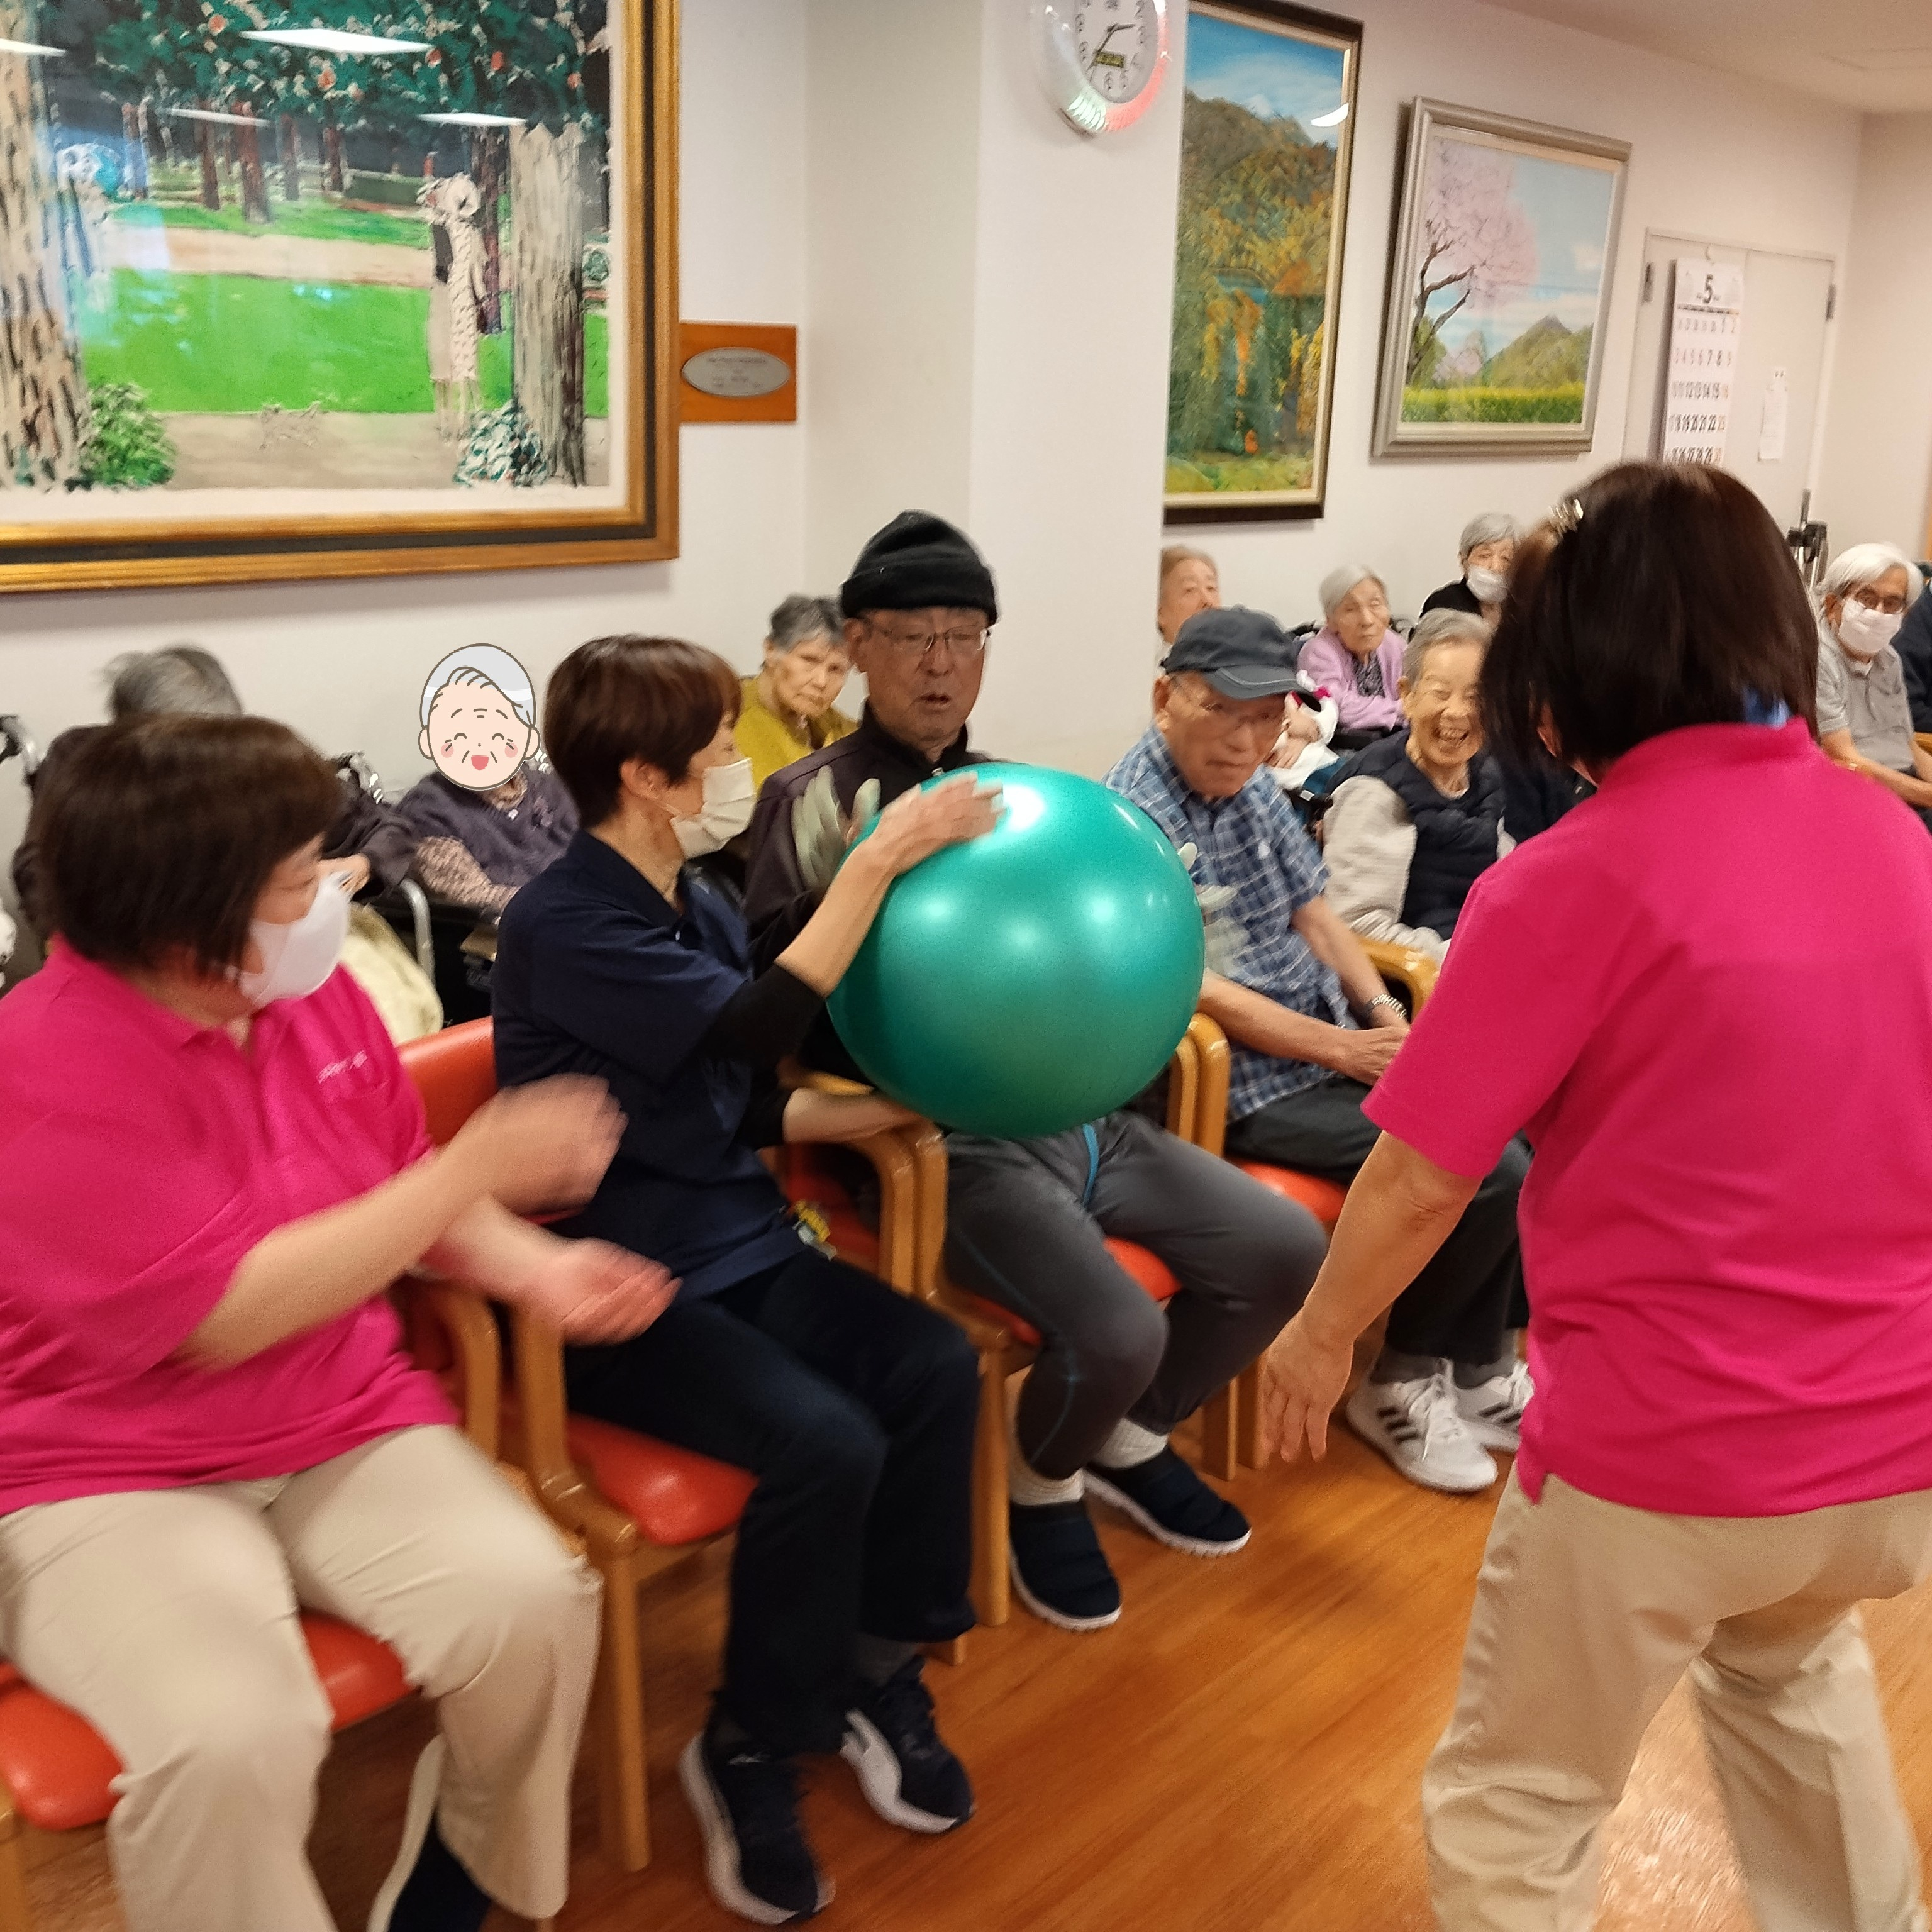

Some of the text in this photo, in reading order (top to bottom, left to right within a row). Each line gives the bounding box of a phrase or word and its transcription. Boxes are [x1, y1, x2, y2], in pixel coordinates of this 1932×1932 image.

[1704, 273, 1714, 304] 5
[1706, 348, 1714, 366] 7
[1715, 349, 1723, 367] 8
